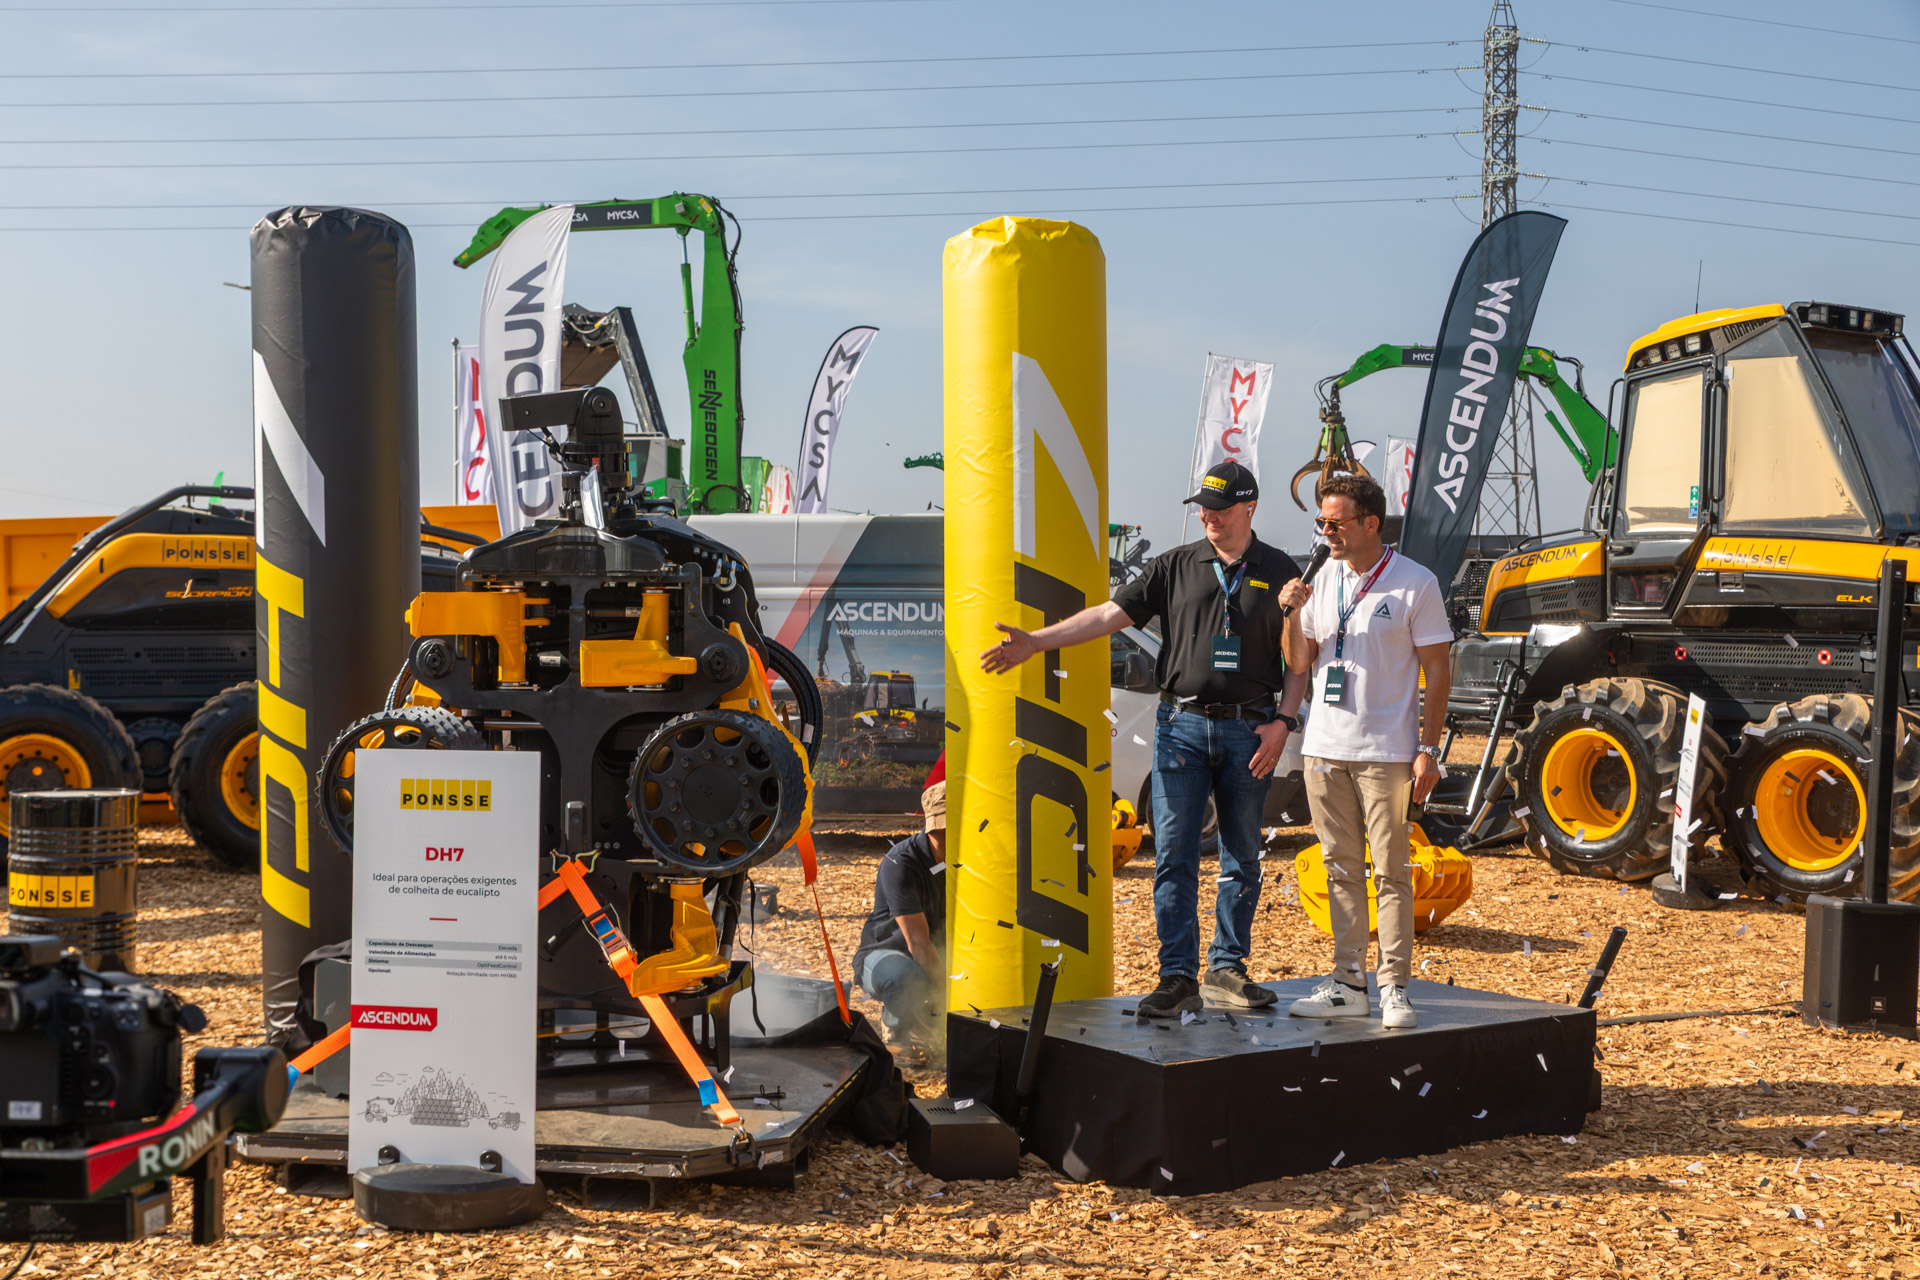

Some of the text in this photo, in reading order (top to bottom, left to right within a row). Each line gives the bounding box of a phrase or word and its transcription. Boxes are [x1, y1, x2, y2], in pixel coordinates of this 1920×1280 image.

[607, 210, 640, 221] MYCSA
[1433, 277, 1521, 515] ASCENDUM
[800, 343, 861, 502] MYCSA
[1220, 367, 1256, 464] MYC
[698, 368, 723, 481] SENNEBOGEN
[166, 548, 246, 560] PONSSE
[1500, 546, 1578, 573] ASCENDUM
[1710, 552, 1788, 566] PONSSE
[1836, 594, 1873, 603] ELK
[402, 793, 489, 807] PONSSE
[425, 847, 465, 862] DH7
[372, 873, 517, 886] Ideal para operações exigentes
[388, 885, 500, 898] de colheita de eucalipto
[358, 1010, 432, 1026] ASCENDUM
[138, 1111, 215, 1177] RONIN
